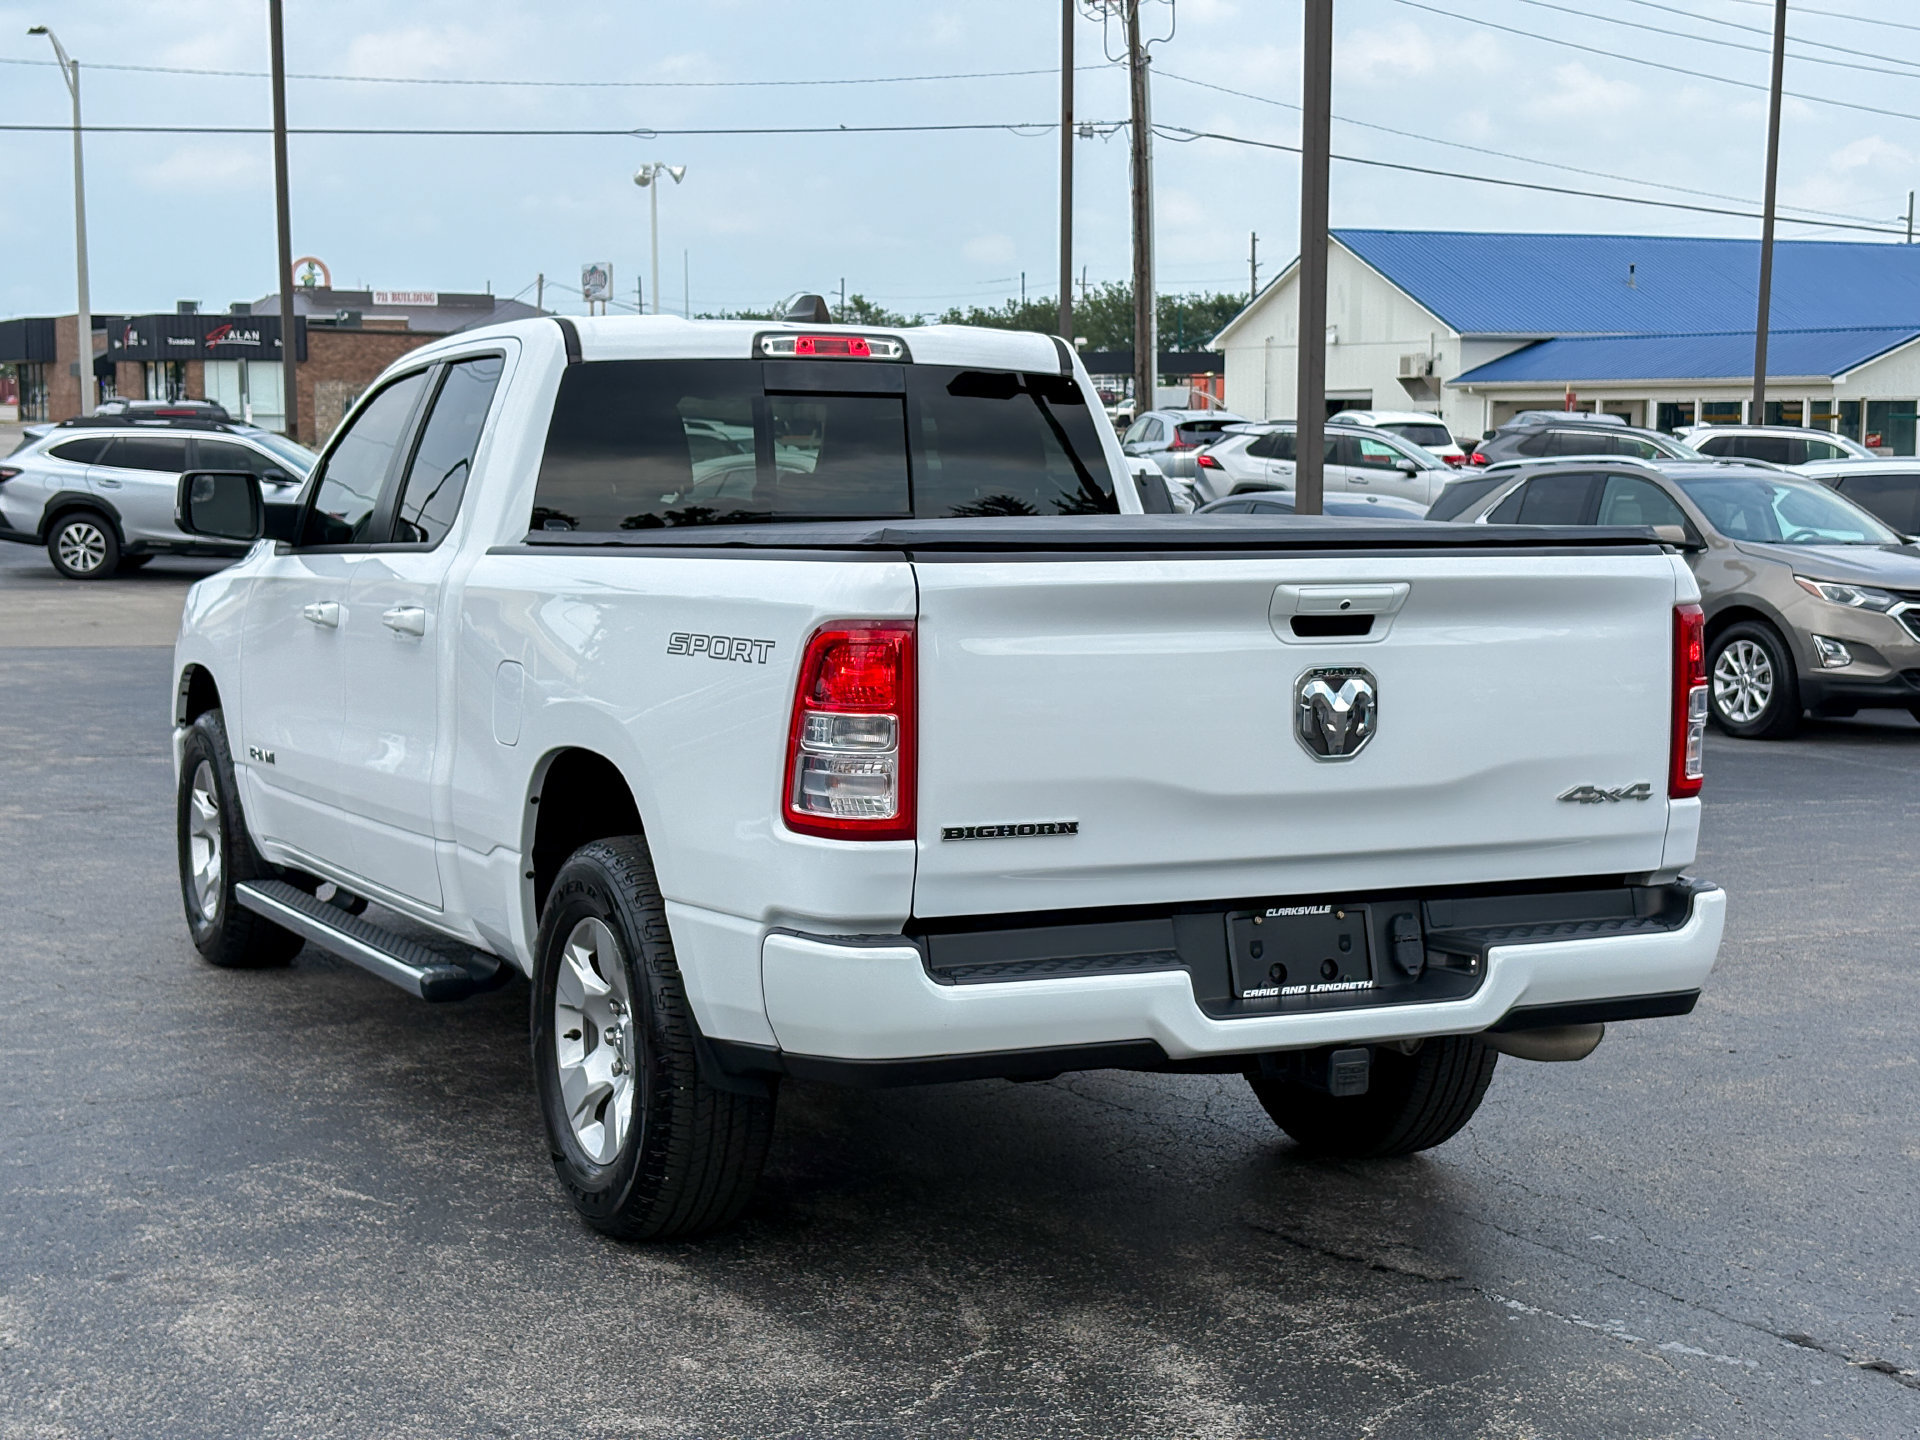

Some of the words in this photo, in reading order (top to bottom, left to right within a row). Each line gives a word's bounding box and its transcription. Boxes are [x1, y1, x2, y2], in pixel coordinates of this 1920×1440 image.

[391, 291, 435, 303] BUILDING
[228, 330, 260, 341] ALAN
[667, 632, 776, 664] SPORT
[249, 744, 276, 766] RAM
[941, 821, 1080, 842] BIGHORN
[1265, 904, 1332, 917] CLARKSVILLE
[1242, 988, 1279, 998] CRAIG
[1281, 984, 1307, 995] AND
[1309, 980, 1374, 993] LANDRETH
